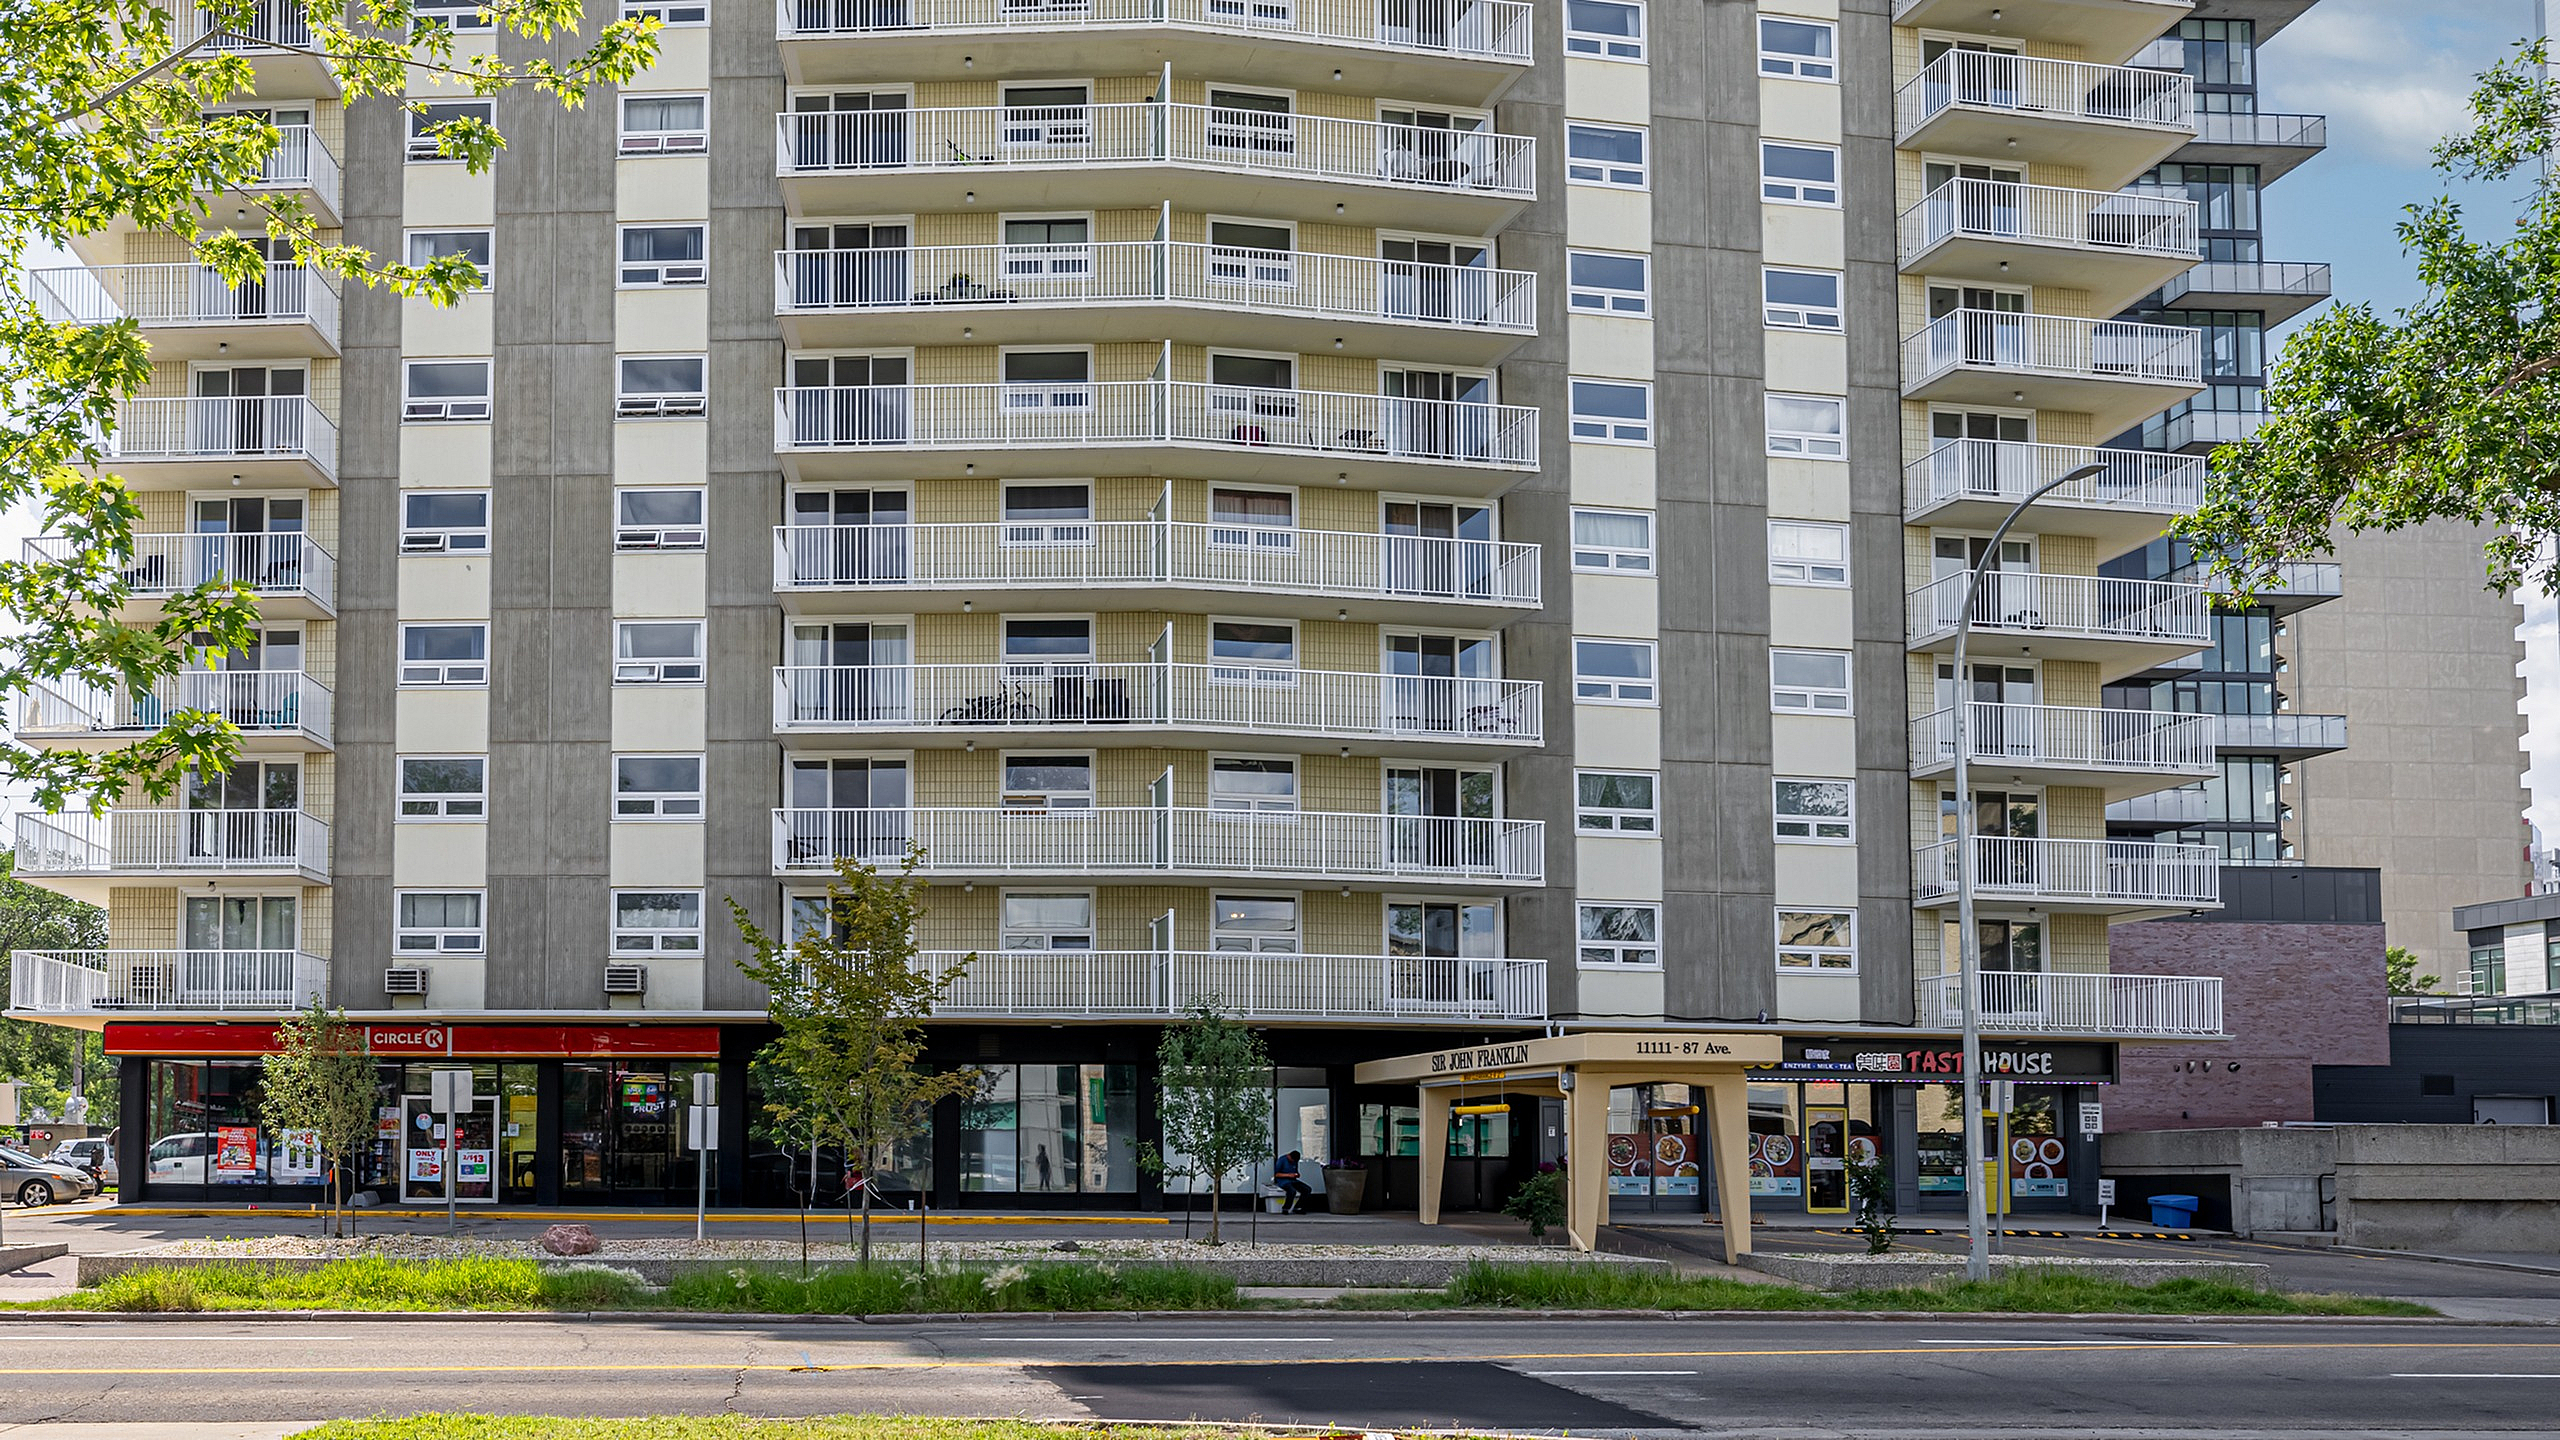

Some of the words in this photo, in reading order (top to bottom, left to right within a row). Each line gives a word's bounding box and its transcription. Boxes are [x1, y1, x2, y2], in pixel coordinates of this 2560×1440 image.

[373, 1032, 422, 1045] CIRCLE
[425, 1029, 443, 1048] K
[1636, 1041, 1672, 1054] 11111
[1682, 1041, 1699, 1055] 87
[1704, 1041, 1732, 1055] Ave.
[1431, 1054, 1447, 1072] SIR
[1449, 1051, 1473, 1071] JOHN
[1477, 1044, 1529, 1067] FRANKLIN
[1906, 1050, 1964, 1073] TAST
[1983, 1051, 2053, 1074] HOUSE
[632, 1099, 677, 1114] FRUSTR
